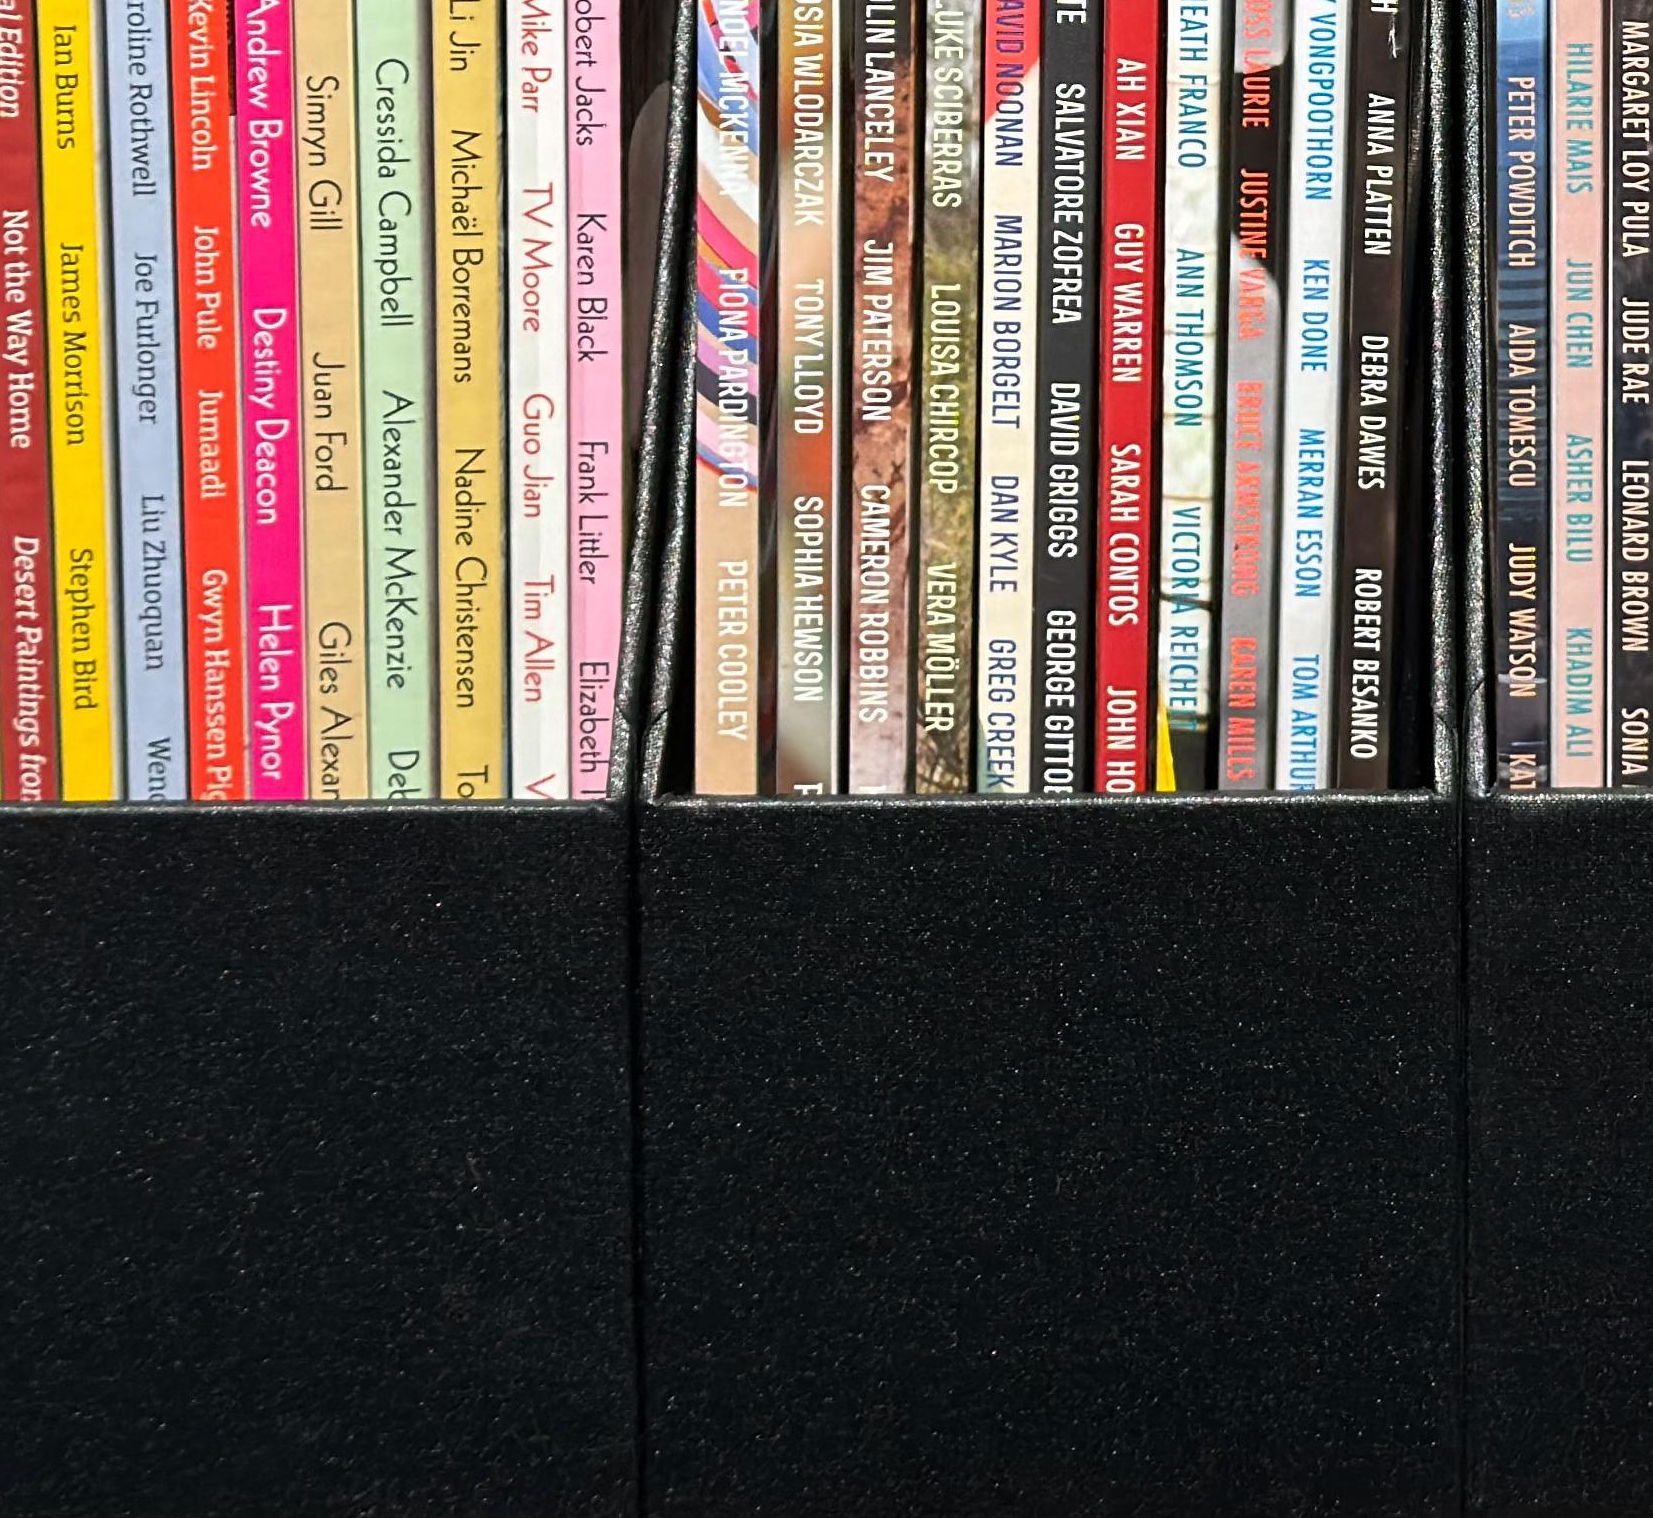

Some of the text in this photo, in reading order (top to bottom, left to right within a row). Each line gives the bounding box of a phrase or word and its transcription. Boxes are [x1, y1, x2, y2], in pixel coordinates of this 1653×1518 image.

[2, 210, 29, 253] Not
[6, 260, 32, 302] the
[2, 310, 32, 366] Way
[60, 243, 89, 445] James Morrison
[132, 253, 160, 424] Joe Furlonger
[194, 226, 226, 498] John Pule Jumaadi
[992, 215, 1022, 429] MARION BORGELT
[1173, 248, 1205, 426] ANN THOMSON
[1509, 324, 1536, 486] AIDA TOMESCU
[8, 373, 34, 448] Home
[383, 390, 416, 689] Alexander McKenzie
[455, 449, 487, 707] Nadine Christensen
[578, 442, 609, 584] Frank Littler
[1295, 429, 1325, 596] MERRAN ESSON
[718, 560, 748, 740] PETER COOLEY
[859, 485, 890, 722] CAMERON ROBBINS
[924, 562, 961, 732] VERA MÖLLER
